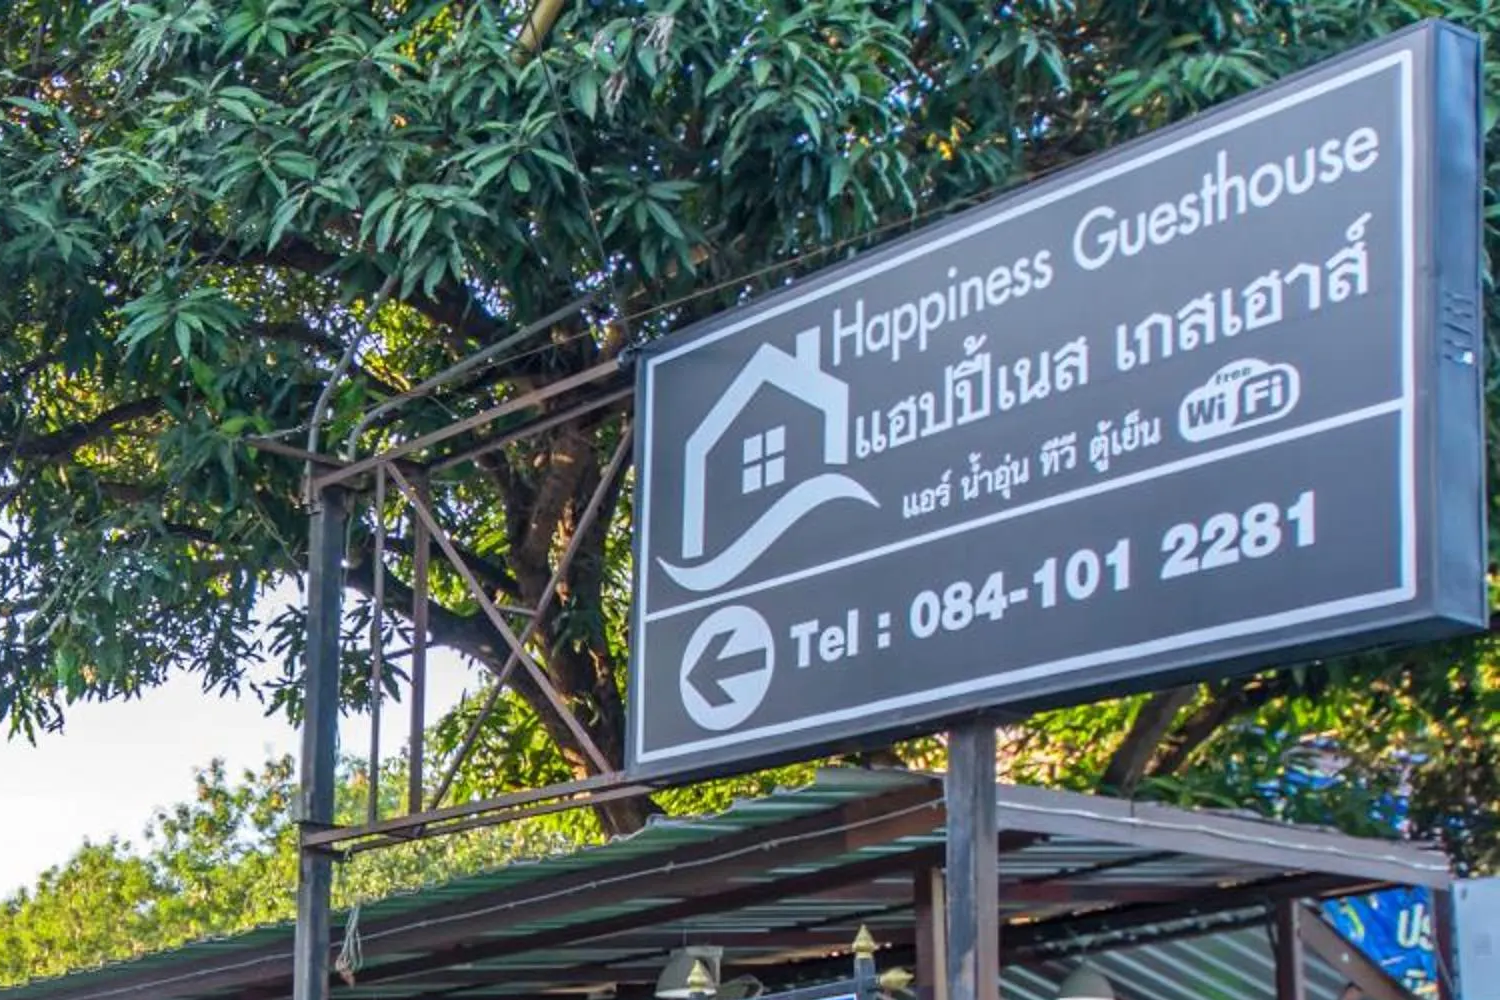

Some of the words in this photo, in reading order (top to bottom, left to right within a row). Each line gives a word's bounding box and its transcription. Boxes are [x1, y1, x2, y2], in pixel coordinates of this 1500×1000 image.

[832, 249, 1053, 366] Happiness
[1072, 126, 1380, 271] Guesthouse
[855, 334, 1090, 460] แฮปปี้เนส
[1116, 211, 1373, 372] เกสเฮาส์
[902, 469, 952, 519] แอร์
[961, 452, 1029, 500] น้ำอุ่น
[1040, 432, 1077, 477] ทีวี
[1089, 408, 1162, 473] ตู้เย็น
[909, 538, 1132, 639] 084-101
[1160, 489, 1315, 580] 2281
